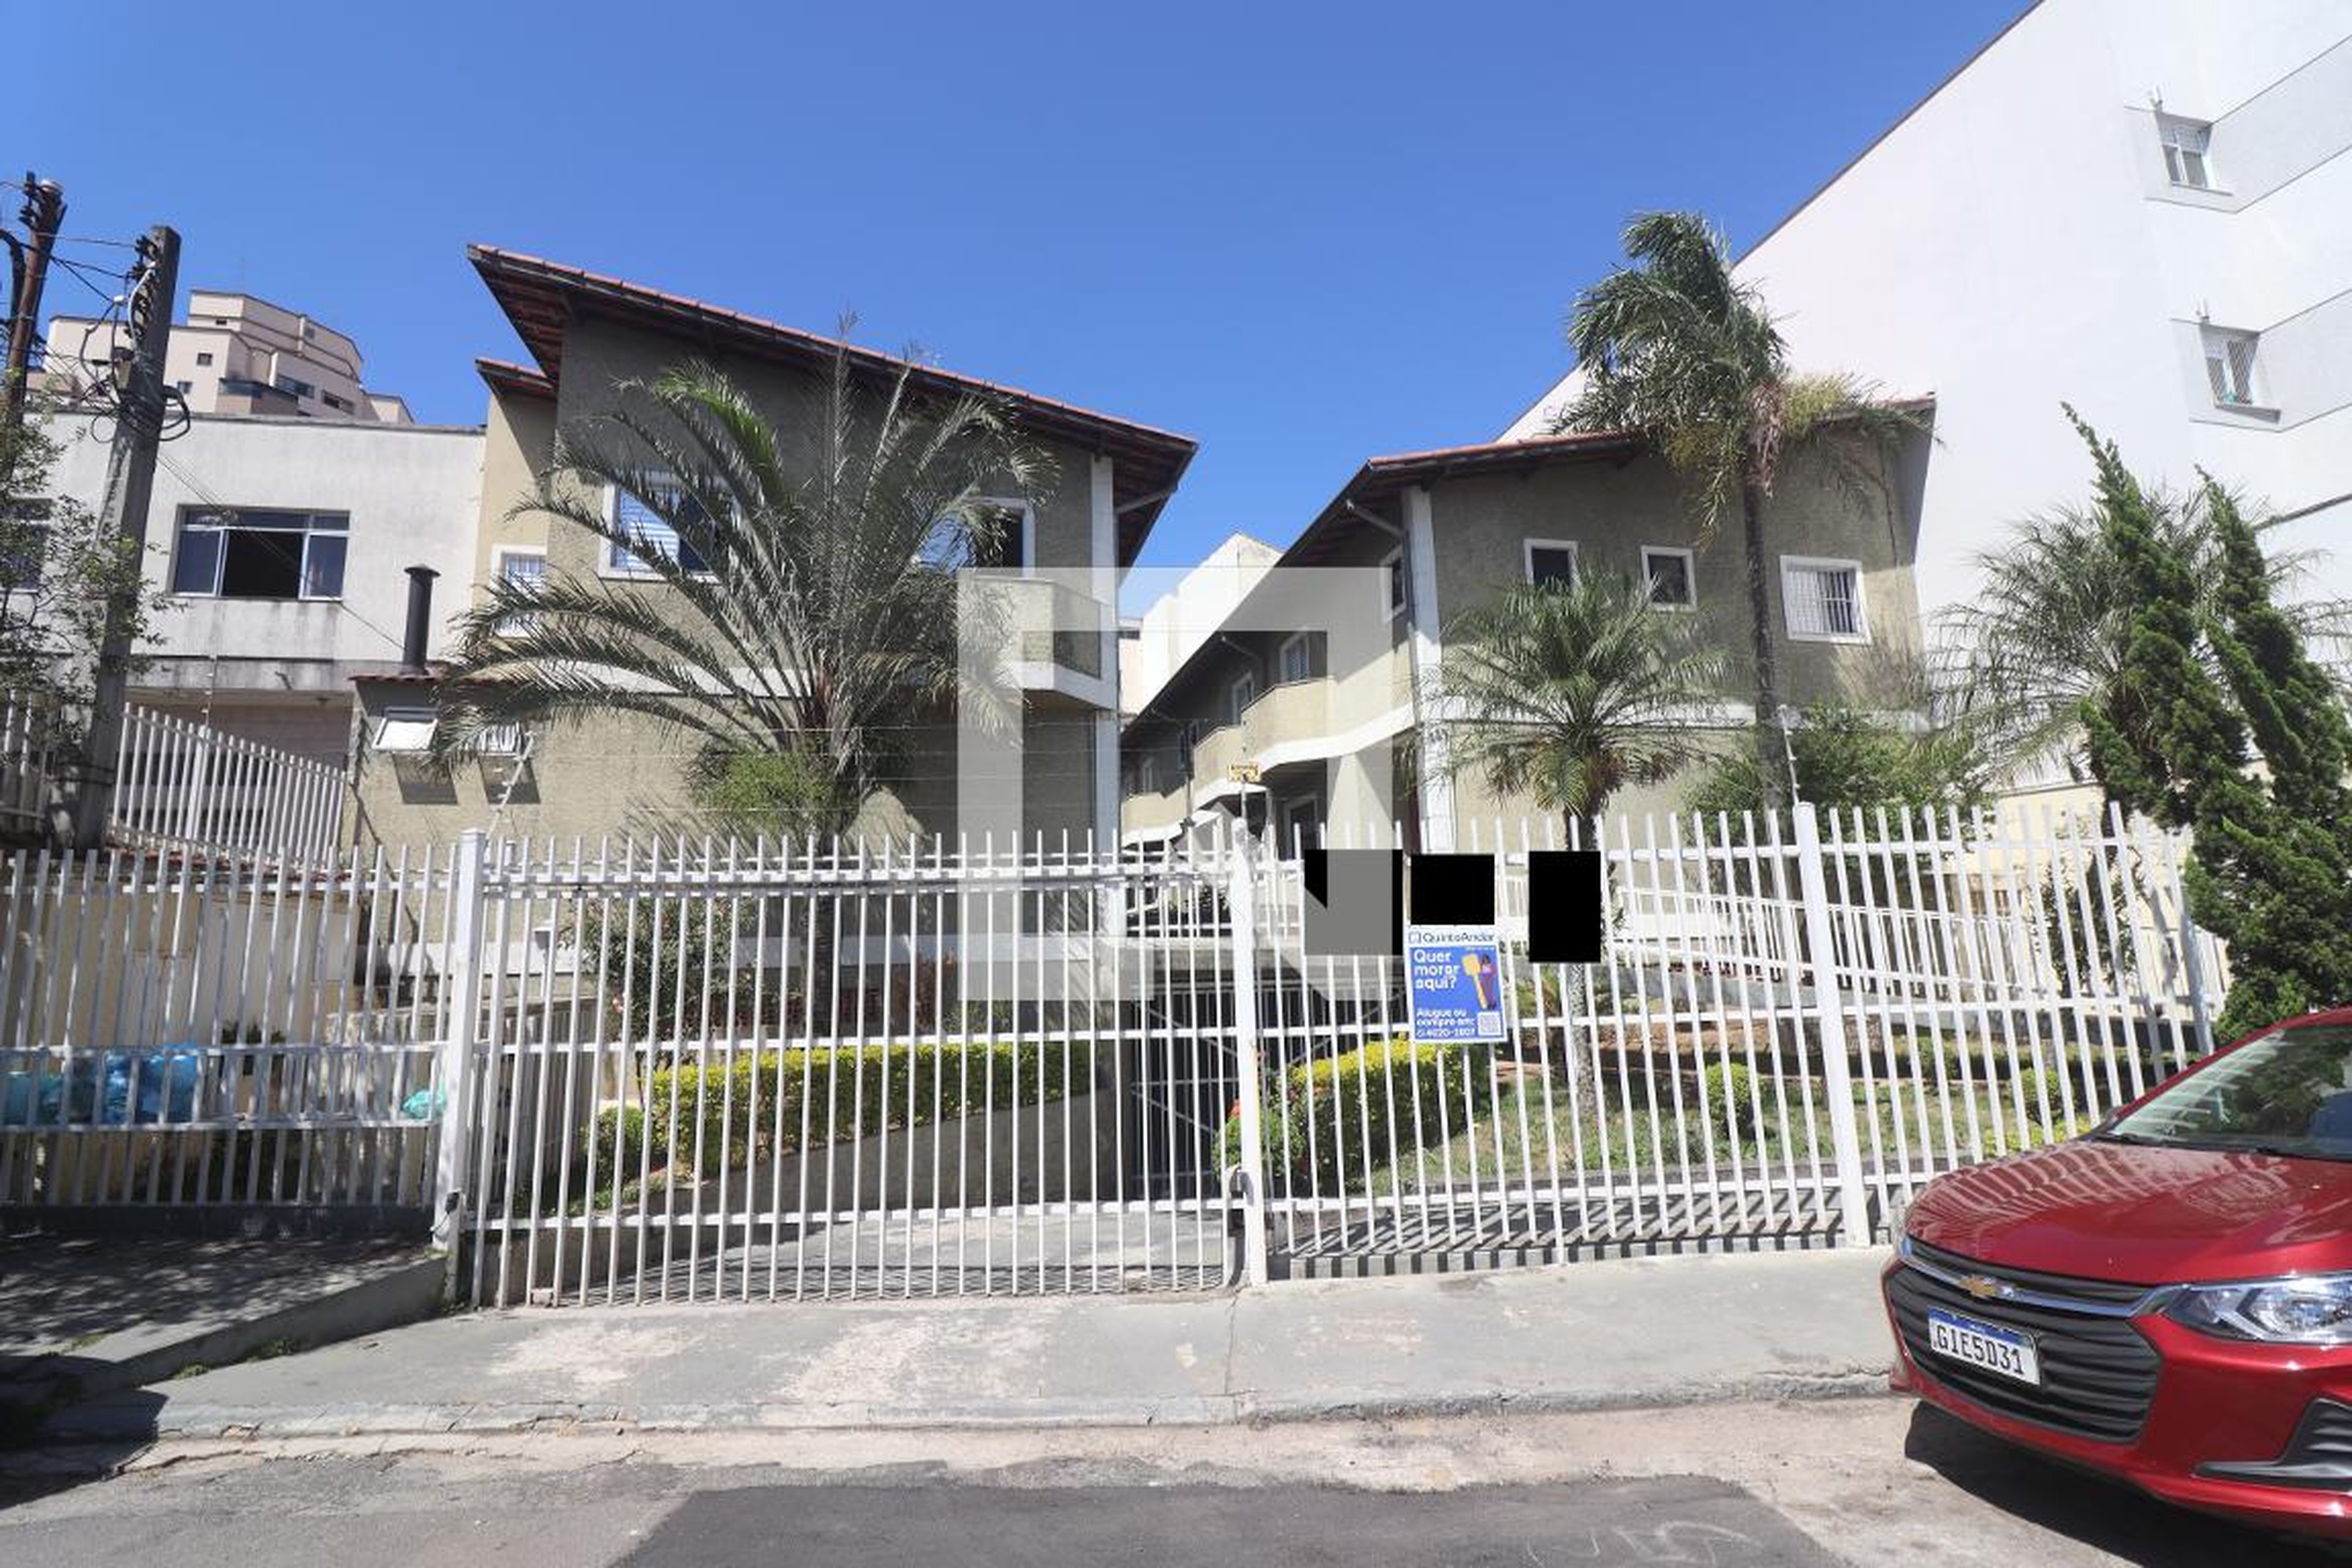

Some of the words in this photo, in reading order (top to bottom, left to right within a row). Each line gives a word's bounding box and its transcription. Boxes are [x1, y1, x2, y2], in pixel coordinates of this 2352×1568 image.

[1422, 932, 1494, 943] QuintoAndar
[1414, 949, 1452, 964] Quer
[1414, 964, 1460, 977] morar
[1415, 974, 1457, 992] aqui?
[1936, 1324, 2024, 1375] GIE5D31
